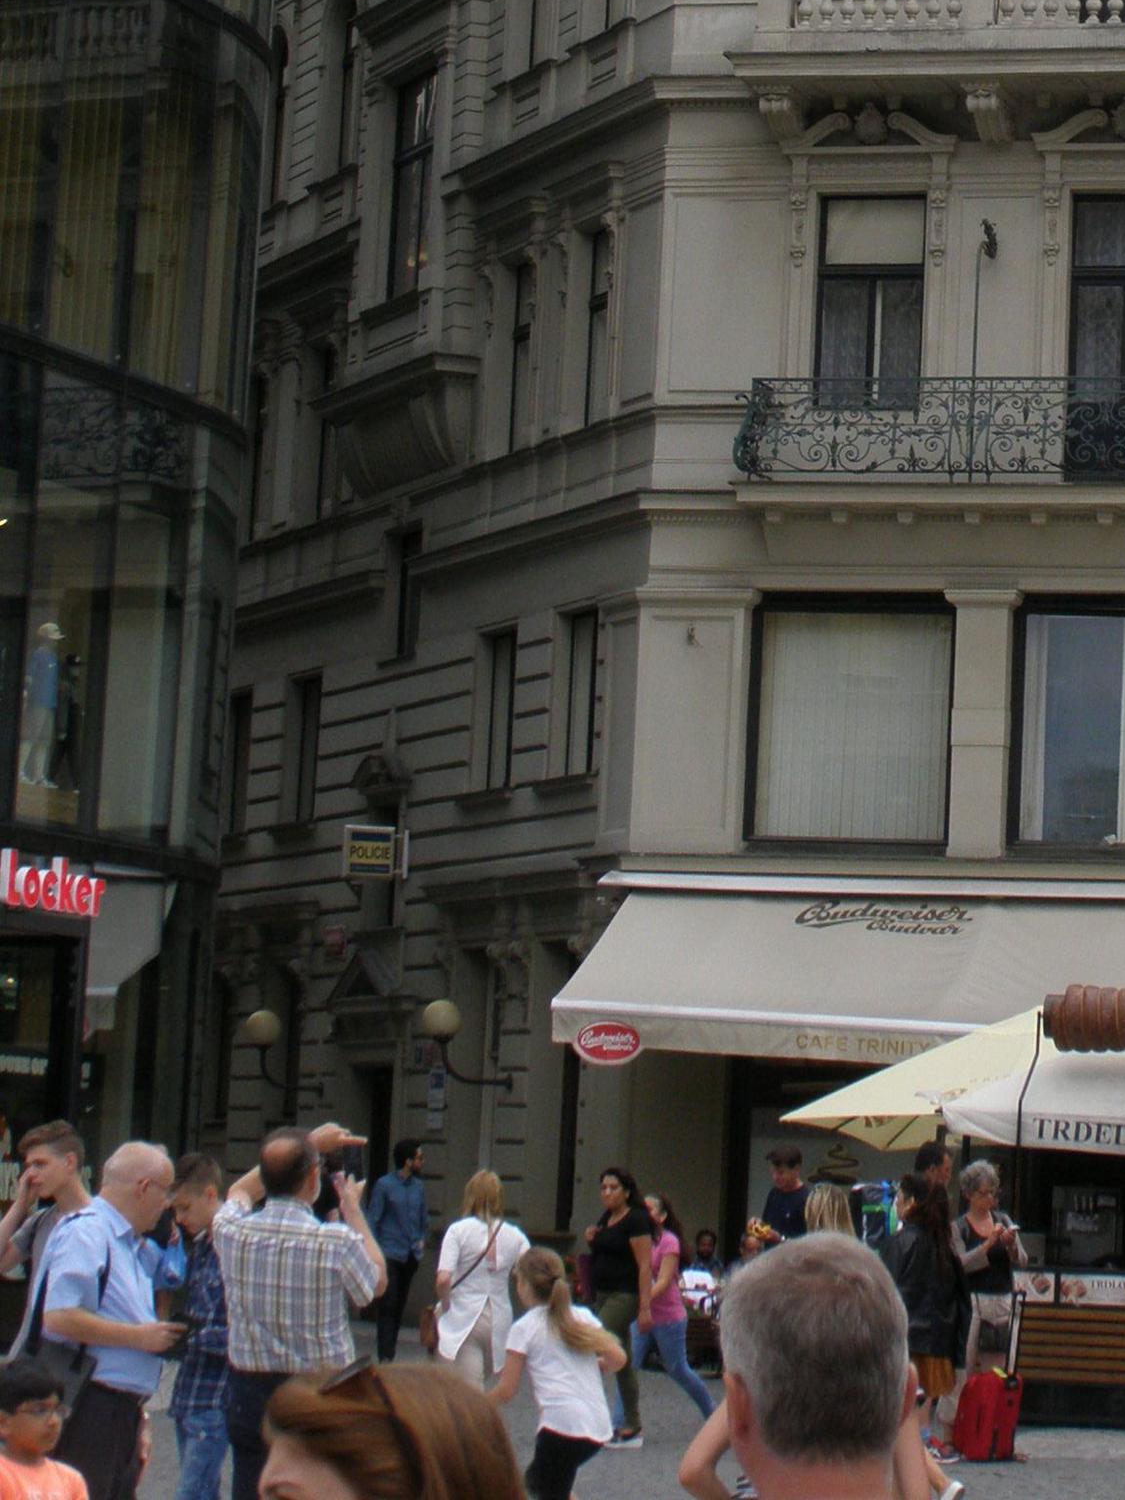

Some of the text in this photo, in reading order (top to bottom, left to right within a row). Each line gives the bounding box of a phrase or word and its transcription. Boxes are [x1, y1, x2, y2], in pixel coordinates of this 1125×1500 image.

[349, 844, 391, 860] POLICIE
[794, 899, 973, 929] Budweiser
[865, 918, 965, 935] Budvar
[855, 1037, 931, 1056] TRINITY
